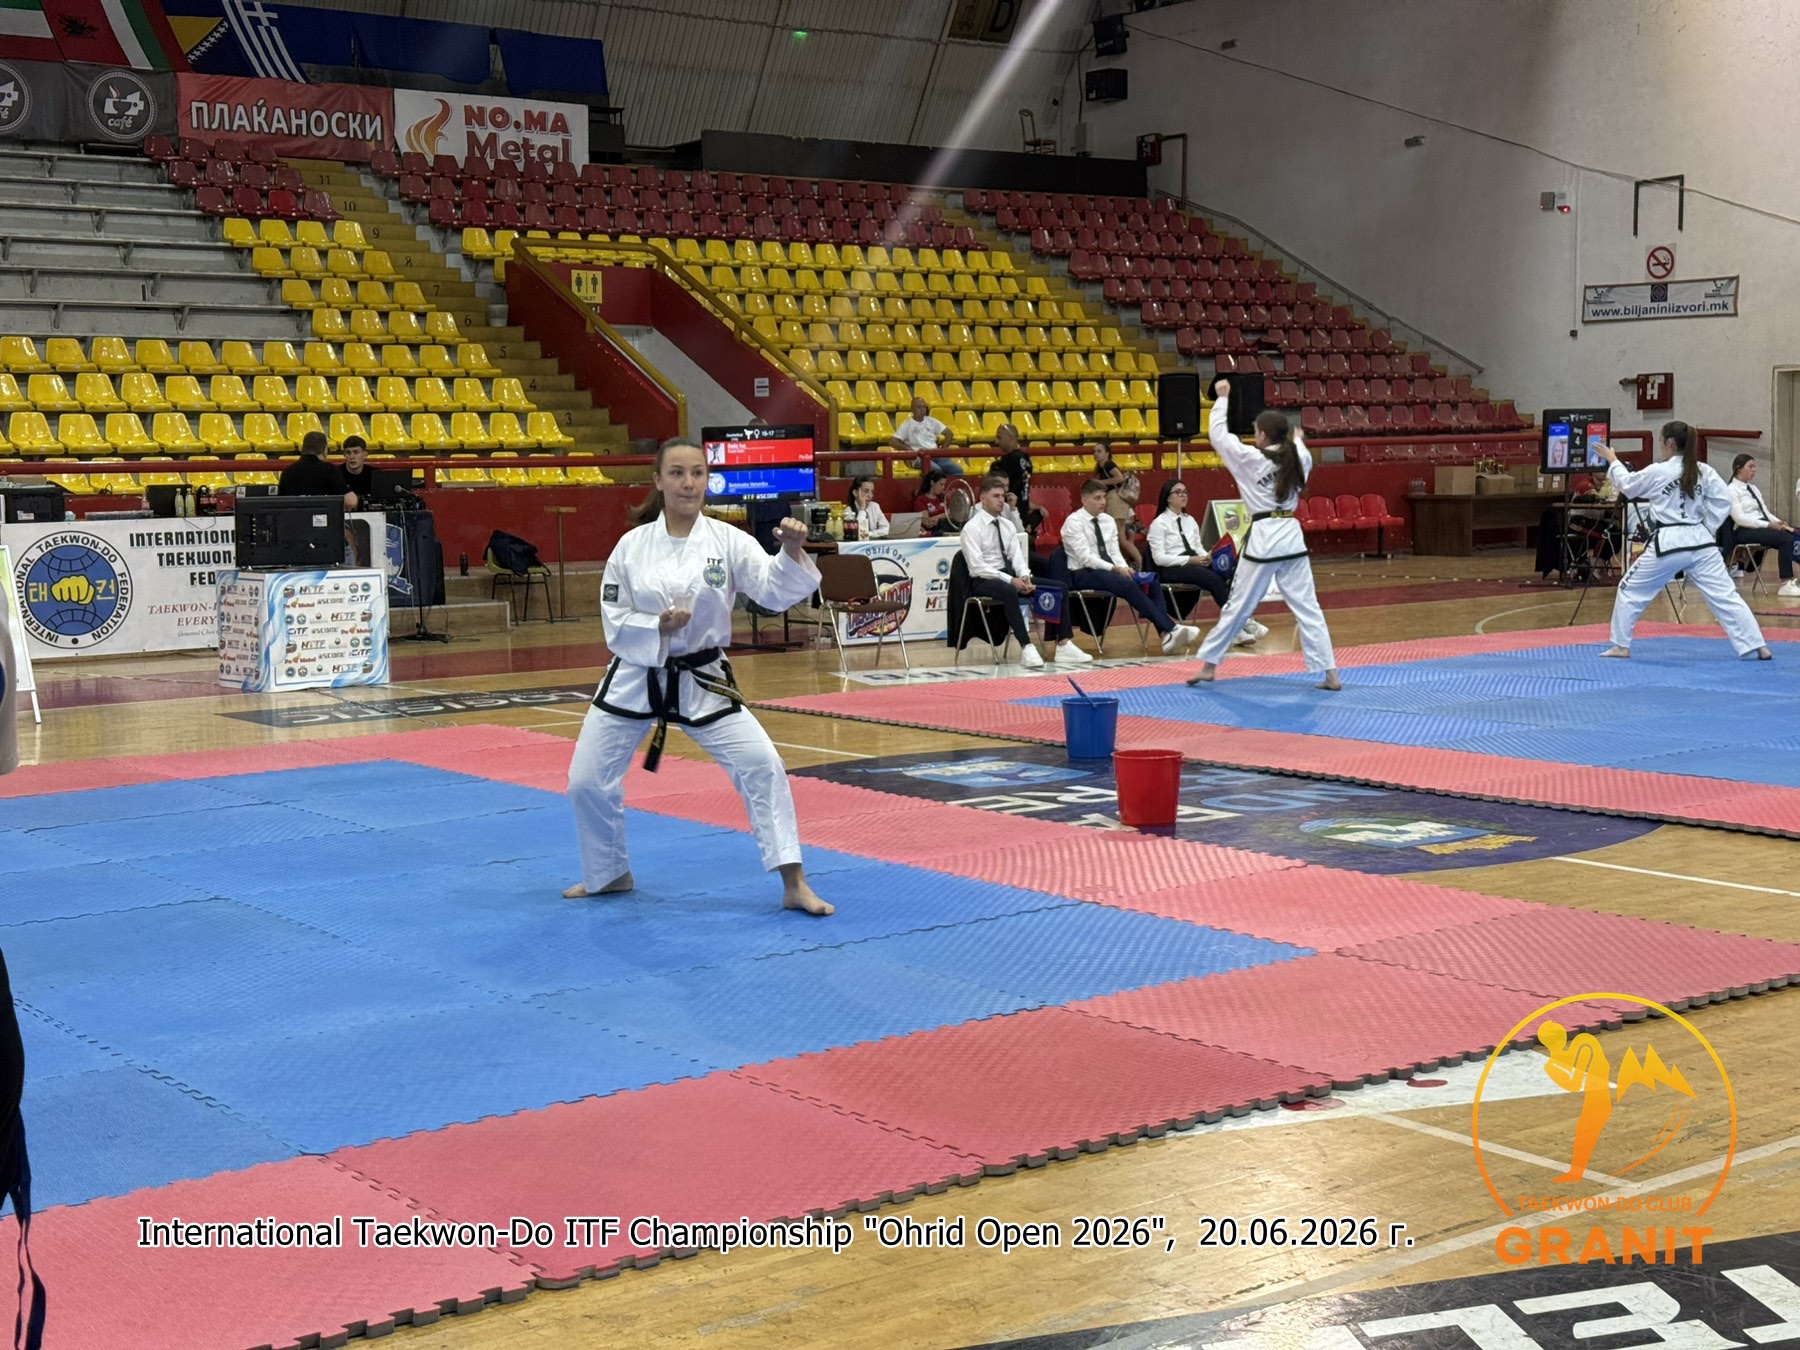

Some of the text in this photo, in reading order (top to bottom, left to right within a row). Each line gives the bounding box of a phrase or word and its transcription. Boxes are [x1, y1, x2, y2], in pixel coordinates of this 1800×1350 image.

[108, 116, 133, 131] café
[190, 98, 383, 141] ПЛАЌАНОСКИ
[464, 105, 571, 136] NO.MA
[466, 131, 571, 165] Metal
[320, 175, 331, 185] 11
[344, 201, 356, 211] 10
[373, 228, 380, 239] 9
[405, 256, 412, 267] 8
[433, 285, 440, 296] 7
[1591, 301, 1729, 318] www.biljaniniizvori.mk
[464, 314, 472, 326] 6
[501, 346, 507, 358] 5
[529, 379, 536, 390] 4
[1646, 382, 1658, 400] H
[566, 412, 572, 425] 3
[707, 557, 723, 566] ITF
[866, 546, 910, 568] Ohrid Open
[36, 534, 118, 564] TAEKWON-DO
[91, 571, 129, 642] FEDERATION
